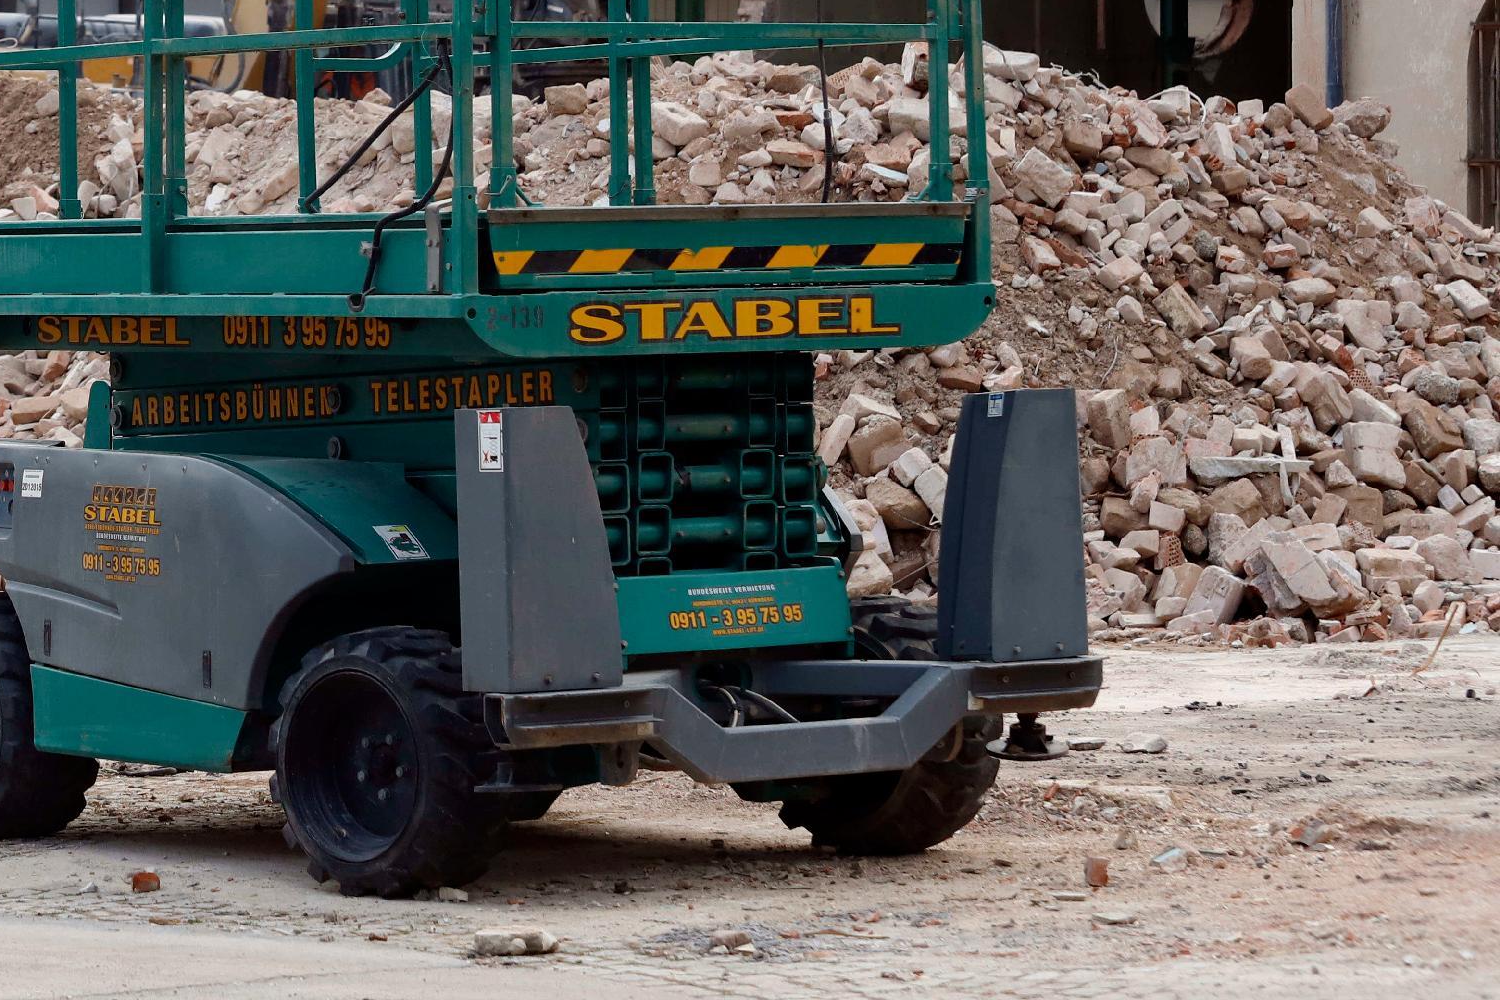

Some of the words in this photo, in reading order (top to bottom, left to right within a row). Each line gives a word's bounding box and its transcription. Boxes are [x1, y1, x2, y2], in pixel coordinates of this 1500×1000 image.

[37, 316, 190, 345] STABEL
[223, 315, 270, 346] 0911
[283, 316, 297, 346] 3
[301, 316, 328, 346] 95
[333, 317, 359, 347] 75
[364, 317, 391, 348] 95
[569, 297, 899, 344] STABEL
[371, 370, 555, 413] TELESTAPLER
[84, 505, 160, 526] STABEL
[83, 553, 103, 572] 0911
[112, 556, 118, 572] 3
[121, 556, 132, 573] 95
[134, 558, 146, 574] 75
[148, 558, 160, 575] 95
[734, 583, 776, 593] VERMIETUNG
[670, 609, 706, 629] 0911
[722, 609, 732, 626] 3
[736, 607, 756, 625] 95
[760, 605, 779, 623] 75
[783, 604, 802, 622] 95
